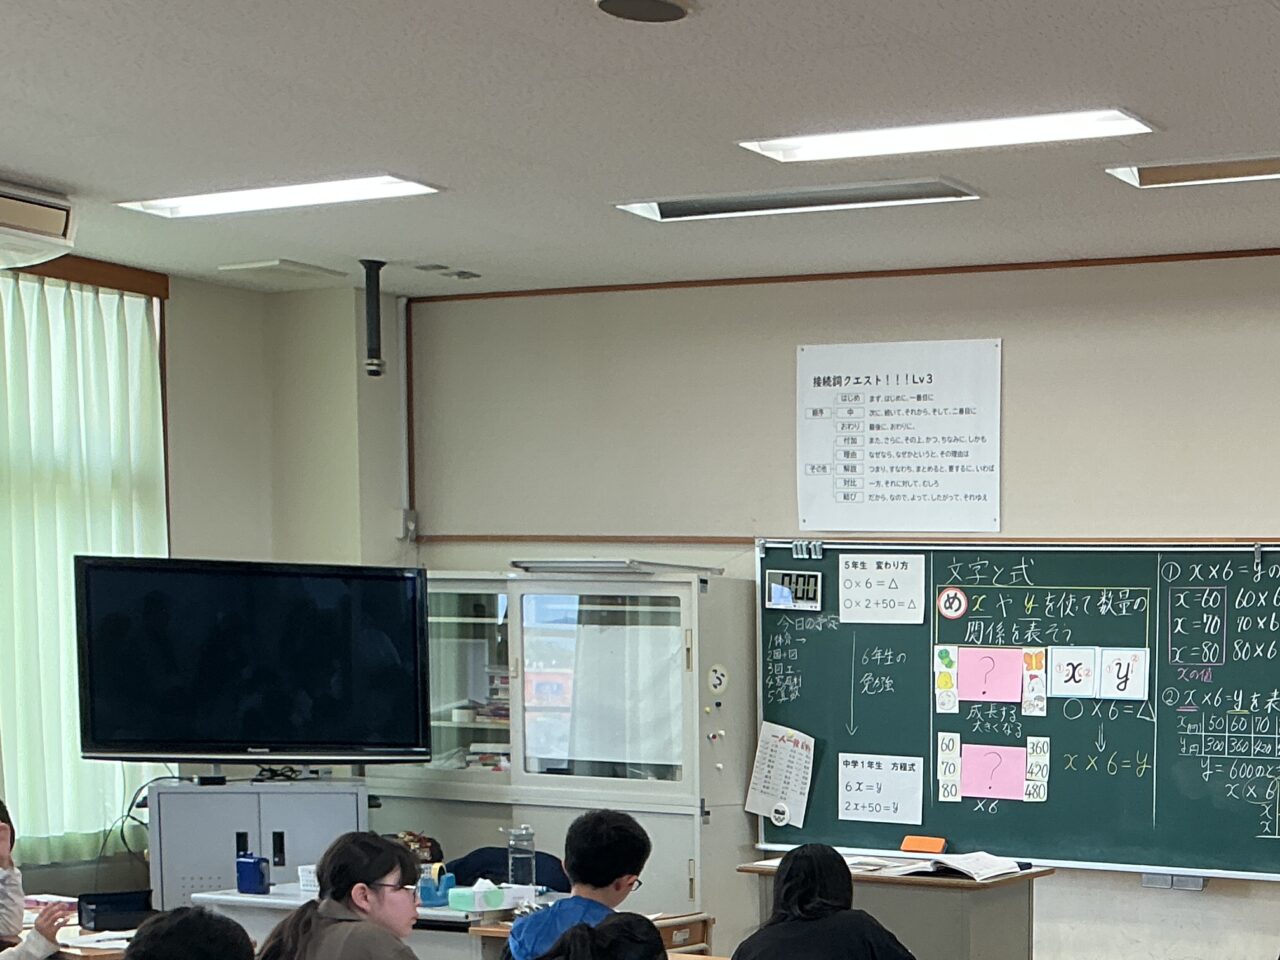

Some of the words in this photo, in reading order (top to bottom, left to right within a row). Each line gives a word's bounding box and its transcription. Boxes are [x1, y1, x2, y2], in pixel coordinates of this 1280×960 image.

[844, 561, 867, 571] 5年生
[875, 561, 909, 571] 変わり方
[946, 556, 1035, 586] 文字と式
[943, 592, 963, 612] め
[861, 646, 907, 665] 6年生の
[1208, 715, 1225, 731] 50
[1230, 715, 1247, 731] 60
[1254, 715, 1270, 734] 70
[940, 737, 955, 752] 60
[1029, 740, 1049, 755] 360
[1206, 736, 1225, 752] 300
[1228, 737, 1250, 753] 360
[1253, 739, 1272, 756] 420
[842, 759, 883, 770] 中学1年生
[891, 762, 917, 773] 方程式
[941, 760, 956, 775] 70
[1027, 763, 1049, 778] 420
[942, 782, 958, 798] 80
[1025, 783, 1046, 799] 480
